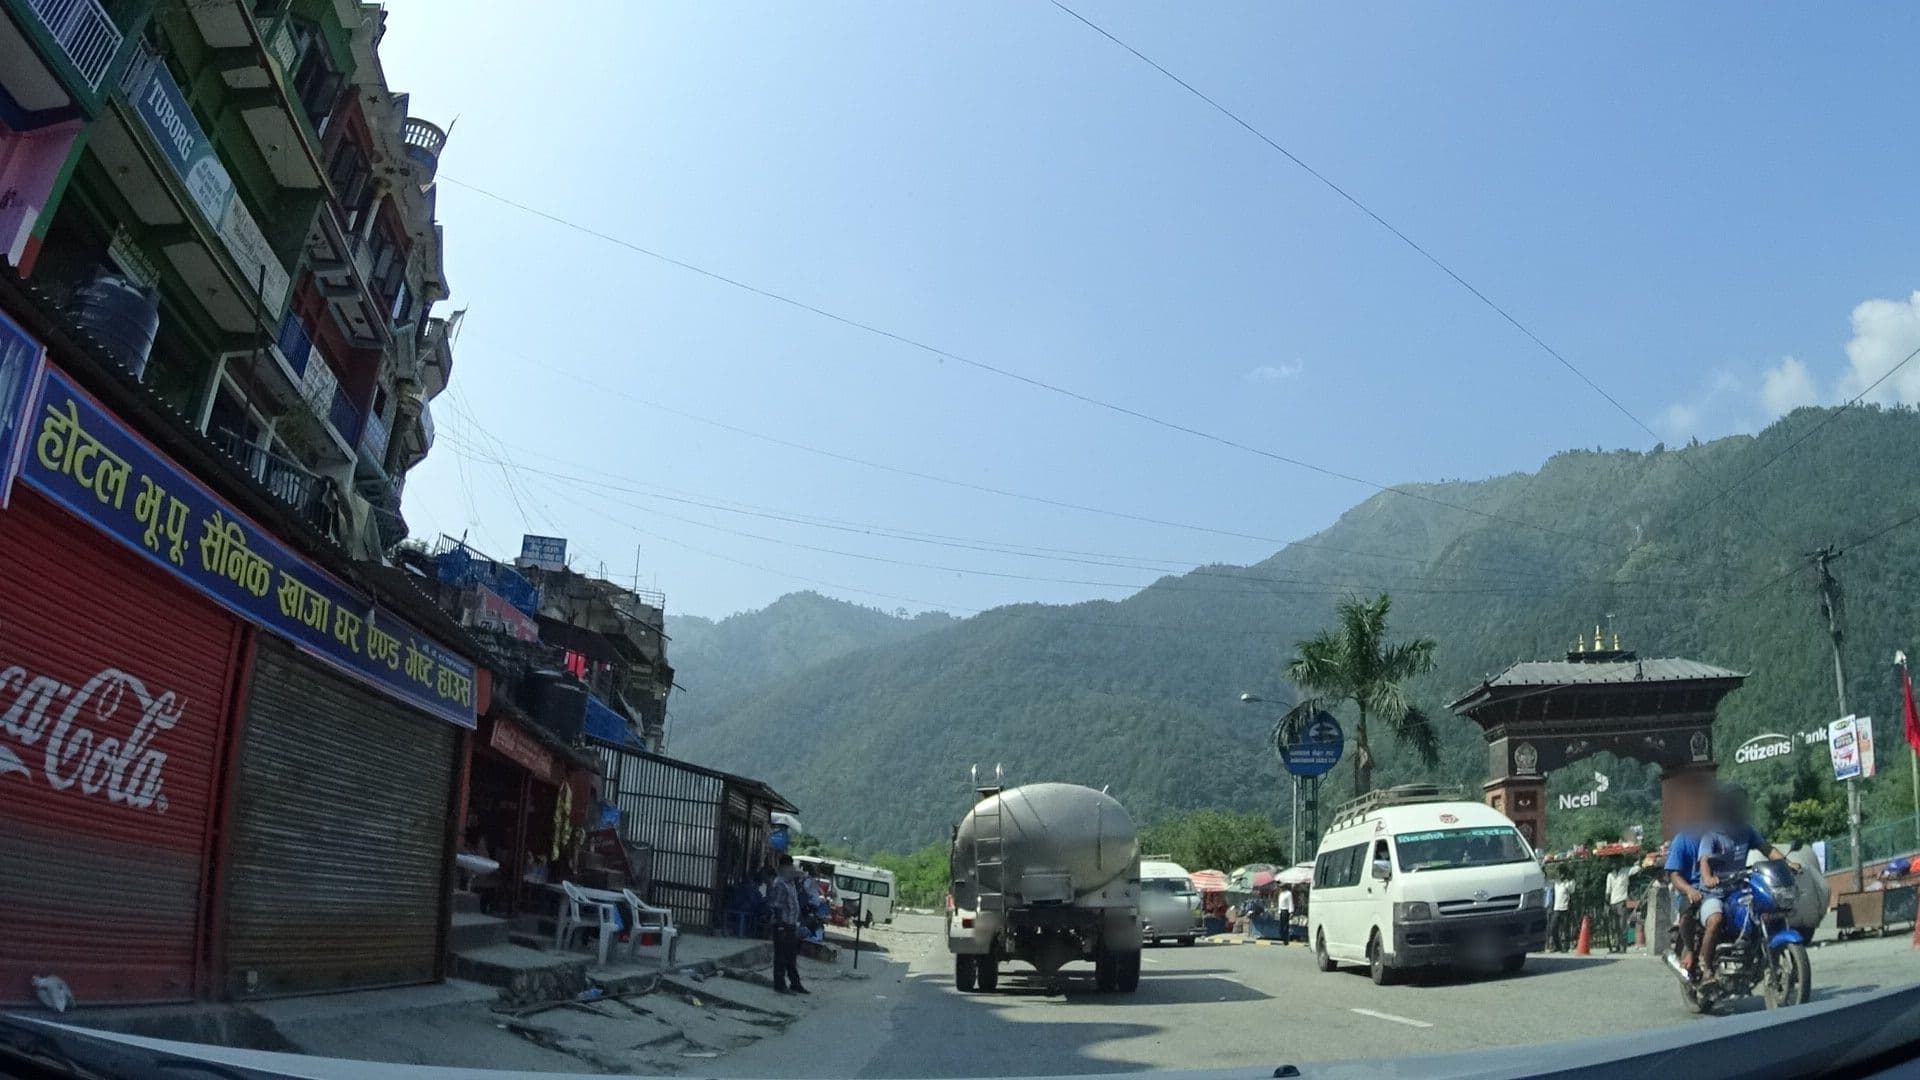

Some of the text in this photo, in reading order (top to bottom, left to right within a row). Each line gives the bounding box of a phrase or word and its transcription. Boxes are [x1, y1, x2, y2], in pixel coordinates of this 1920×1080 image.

[147, 78, 195, 161] TUBORG
[37, 399, 132, 510] होटल
[200, 510, 273, 597] सैनिक
[277, 570, 331, 633] खाजा
[334, 605, 362, 653] घर
[437, 664, 472, 708] हाउस
[45, 668, 188, 808] Cola
[1735, 741, 1791, 764] Citizens
[1798, 727, 1828, 744] ank
[1559, 790, 1597, 810] Ncell
